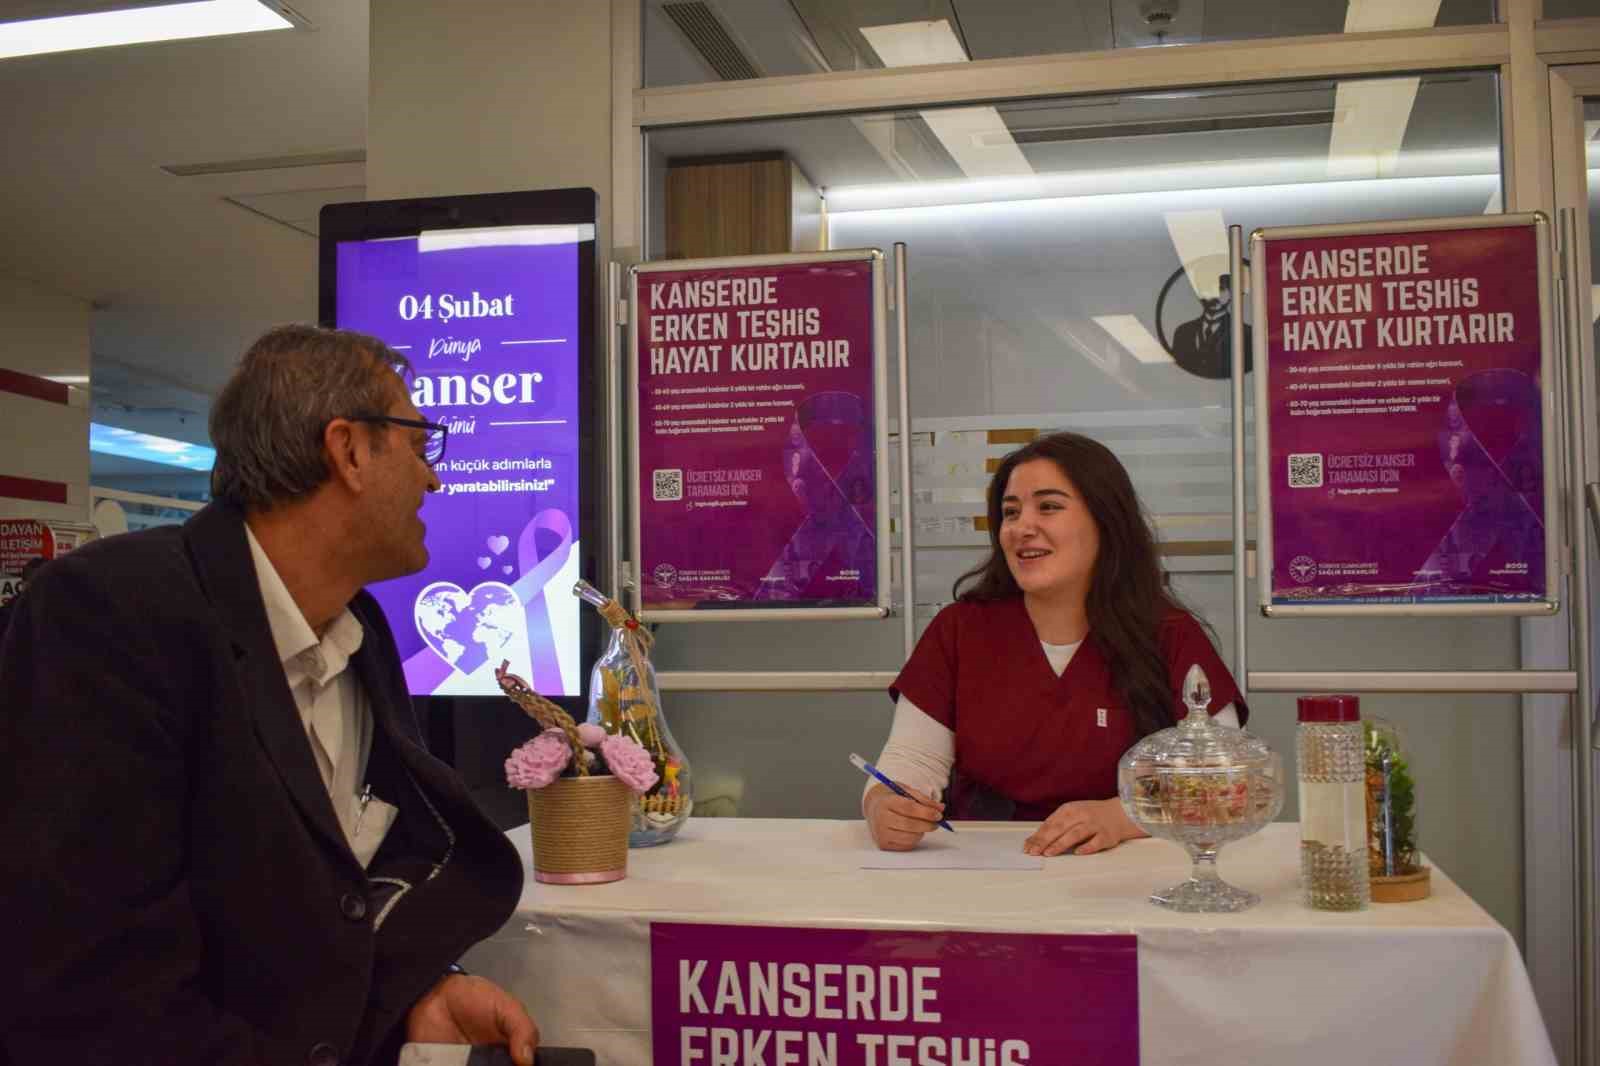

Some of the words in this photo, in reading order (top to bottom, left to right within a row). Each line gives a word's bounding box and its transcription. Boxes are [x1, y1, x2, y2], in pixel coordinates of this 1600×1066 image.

[1281, 244, 1429, 281] KANSERDE
[399, 294, 433, 321] 04
[439, 291, 514, 324] Şubat
[651, 276, 777, 310] KANSERDE
[1282, 283, 1372, 316] ERKEN
[1382, 278, 1479, 312] TEŞHİS
[651, 312, 728, 342] ERKEN
[737, 308, 820, 339] TEŞHİS
[1283, 319, 1366, 352] HAYAT
[1377, 312, 1514, 348] KURTARIR
[428, 336, 481, 361] Dünya
[651, 345, 722, 375] HAYAT
[731, 340, 849, 372] KURTARIR
[411, 371, 543, 408] anser
[450, 459, 490, 474] küçük
[492, 458, 552, 471] adımlarla
[678, 958, 942, 1024] KANSERDE
[680, 1025, 838, 1066] ERKEN
